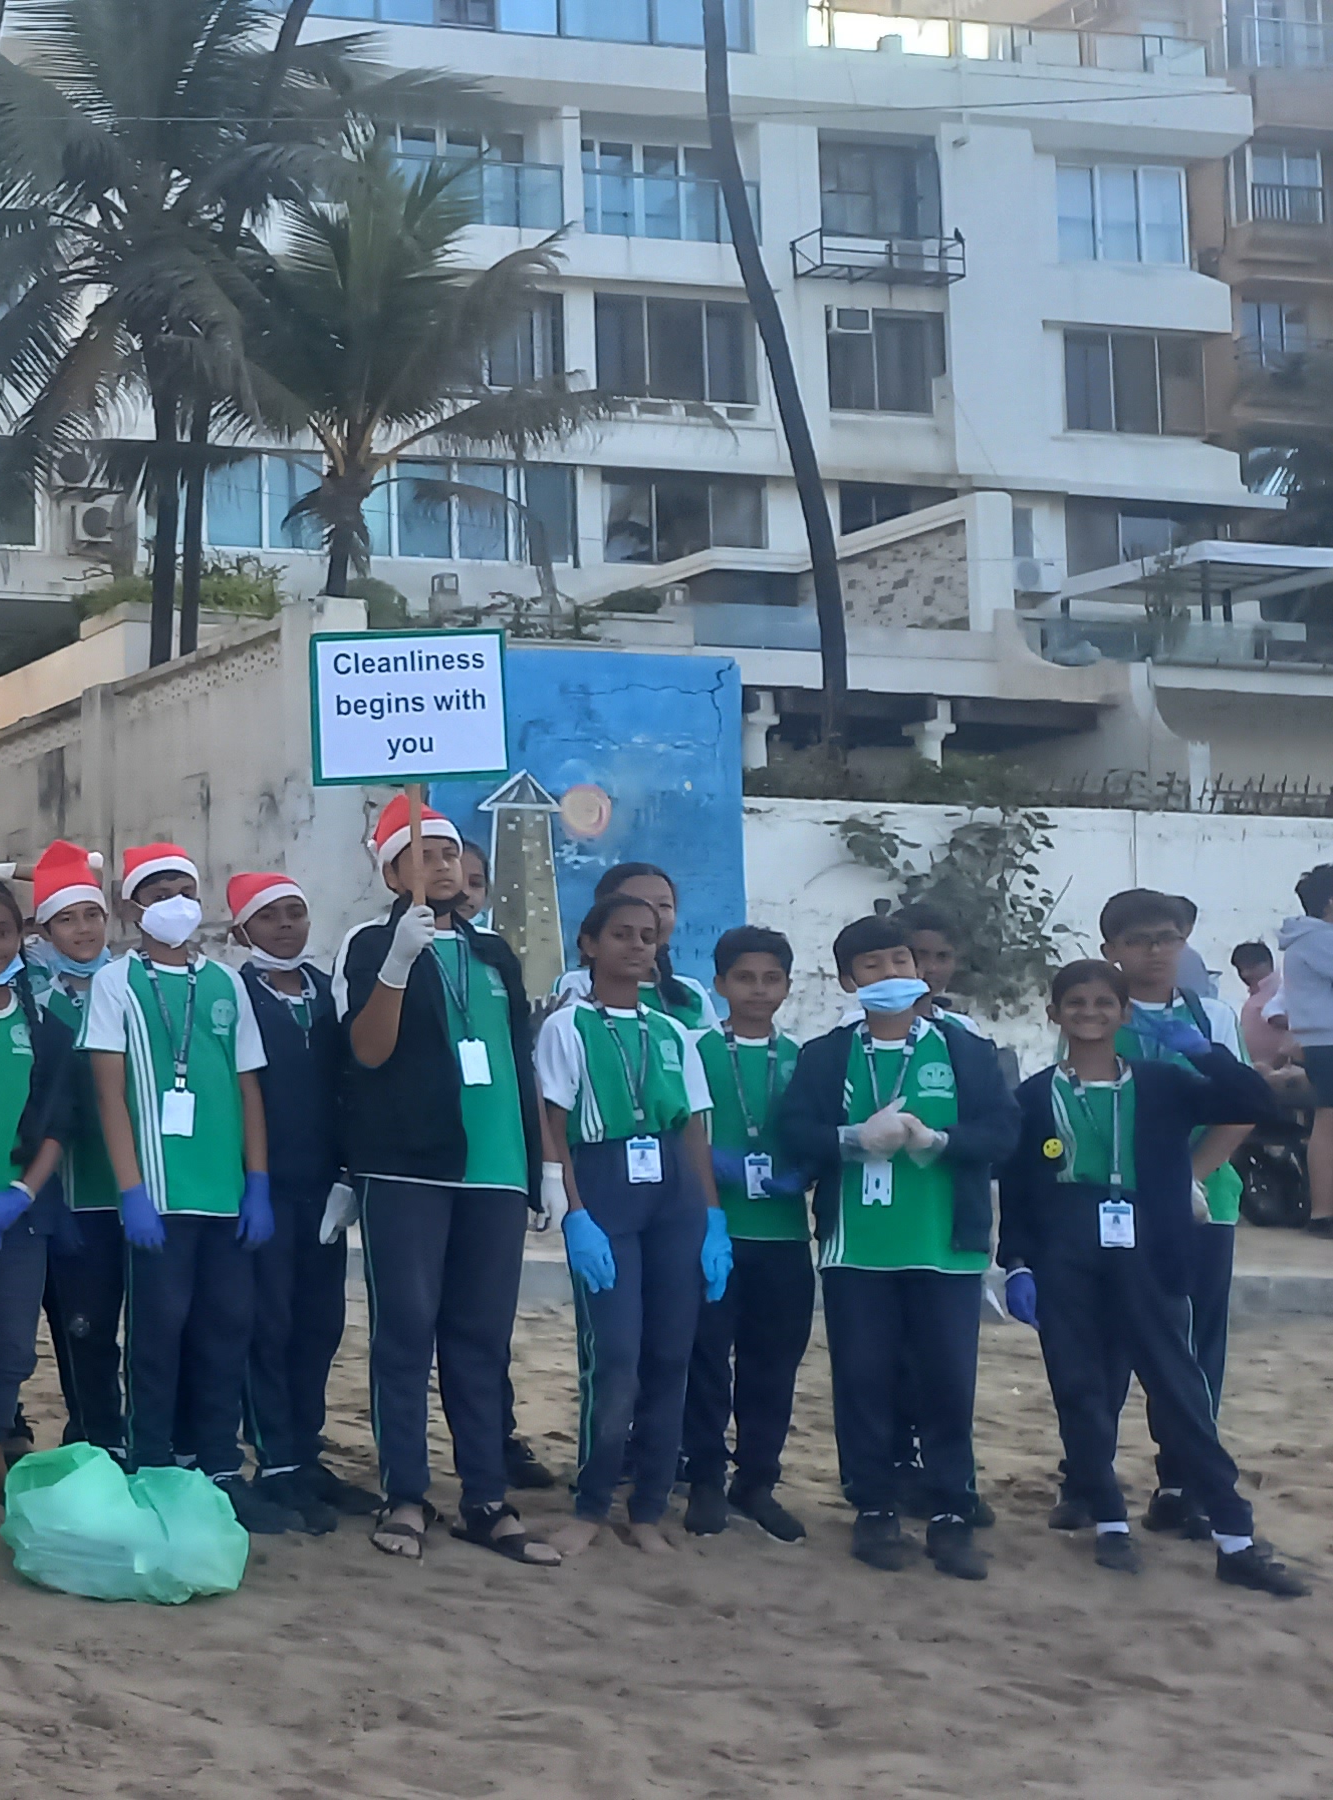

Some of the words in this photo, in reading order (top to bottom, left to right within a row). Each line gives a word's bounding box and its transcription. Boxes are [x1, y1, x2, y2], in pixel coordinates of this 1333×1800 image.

[333, 649, 485, 675] Cleanliness
[335, 692, 425, 720] begins
[433, 688, 486, 711] with
[386, 736, 434, 761] you
